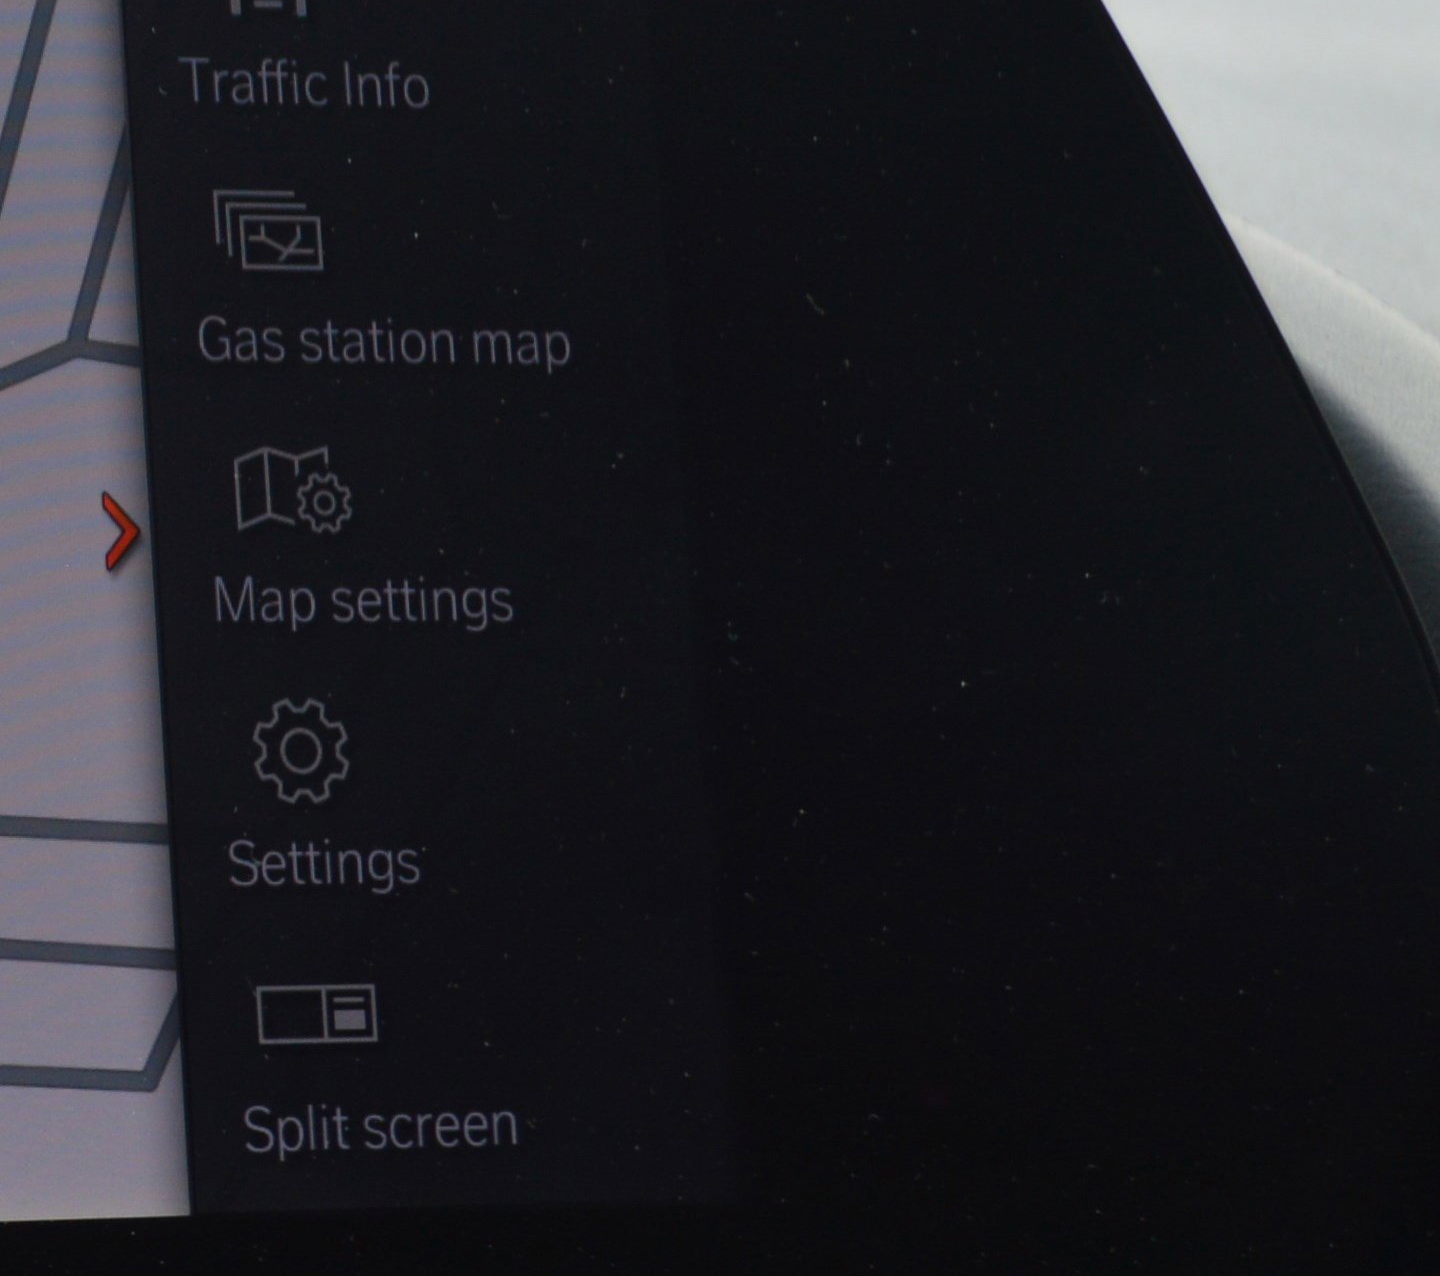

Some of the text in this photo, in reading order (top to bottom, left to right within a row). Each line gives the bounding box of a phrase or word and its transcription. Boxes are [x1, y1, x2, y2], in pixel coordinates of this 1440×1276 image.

[178, 56, 430, 109] Traffic Info
[197, 315, 571, 374] Gas station map
[214, 575, 514, 632] Map settings
[228, 839, 418, 895] Settings
[244, 1104, 518, 1161] Split screen
